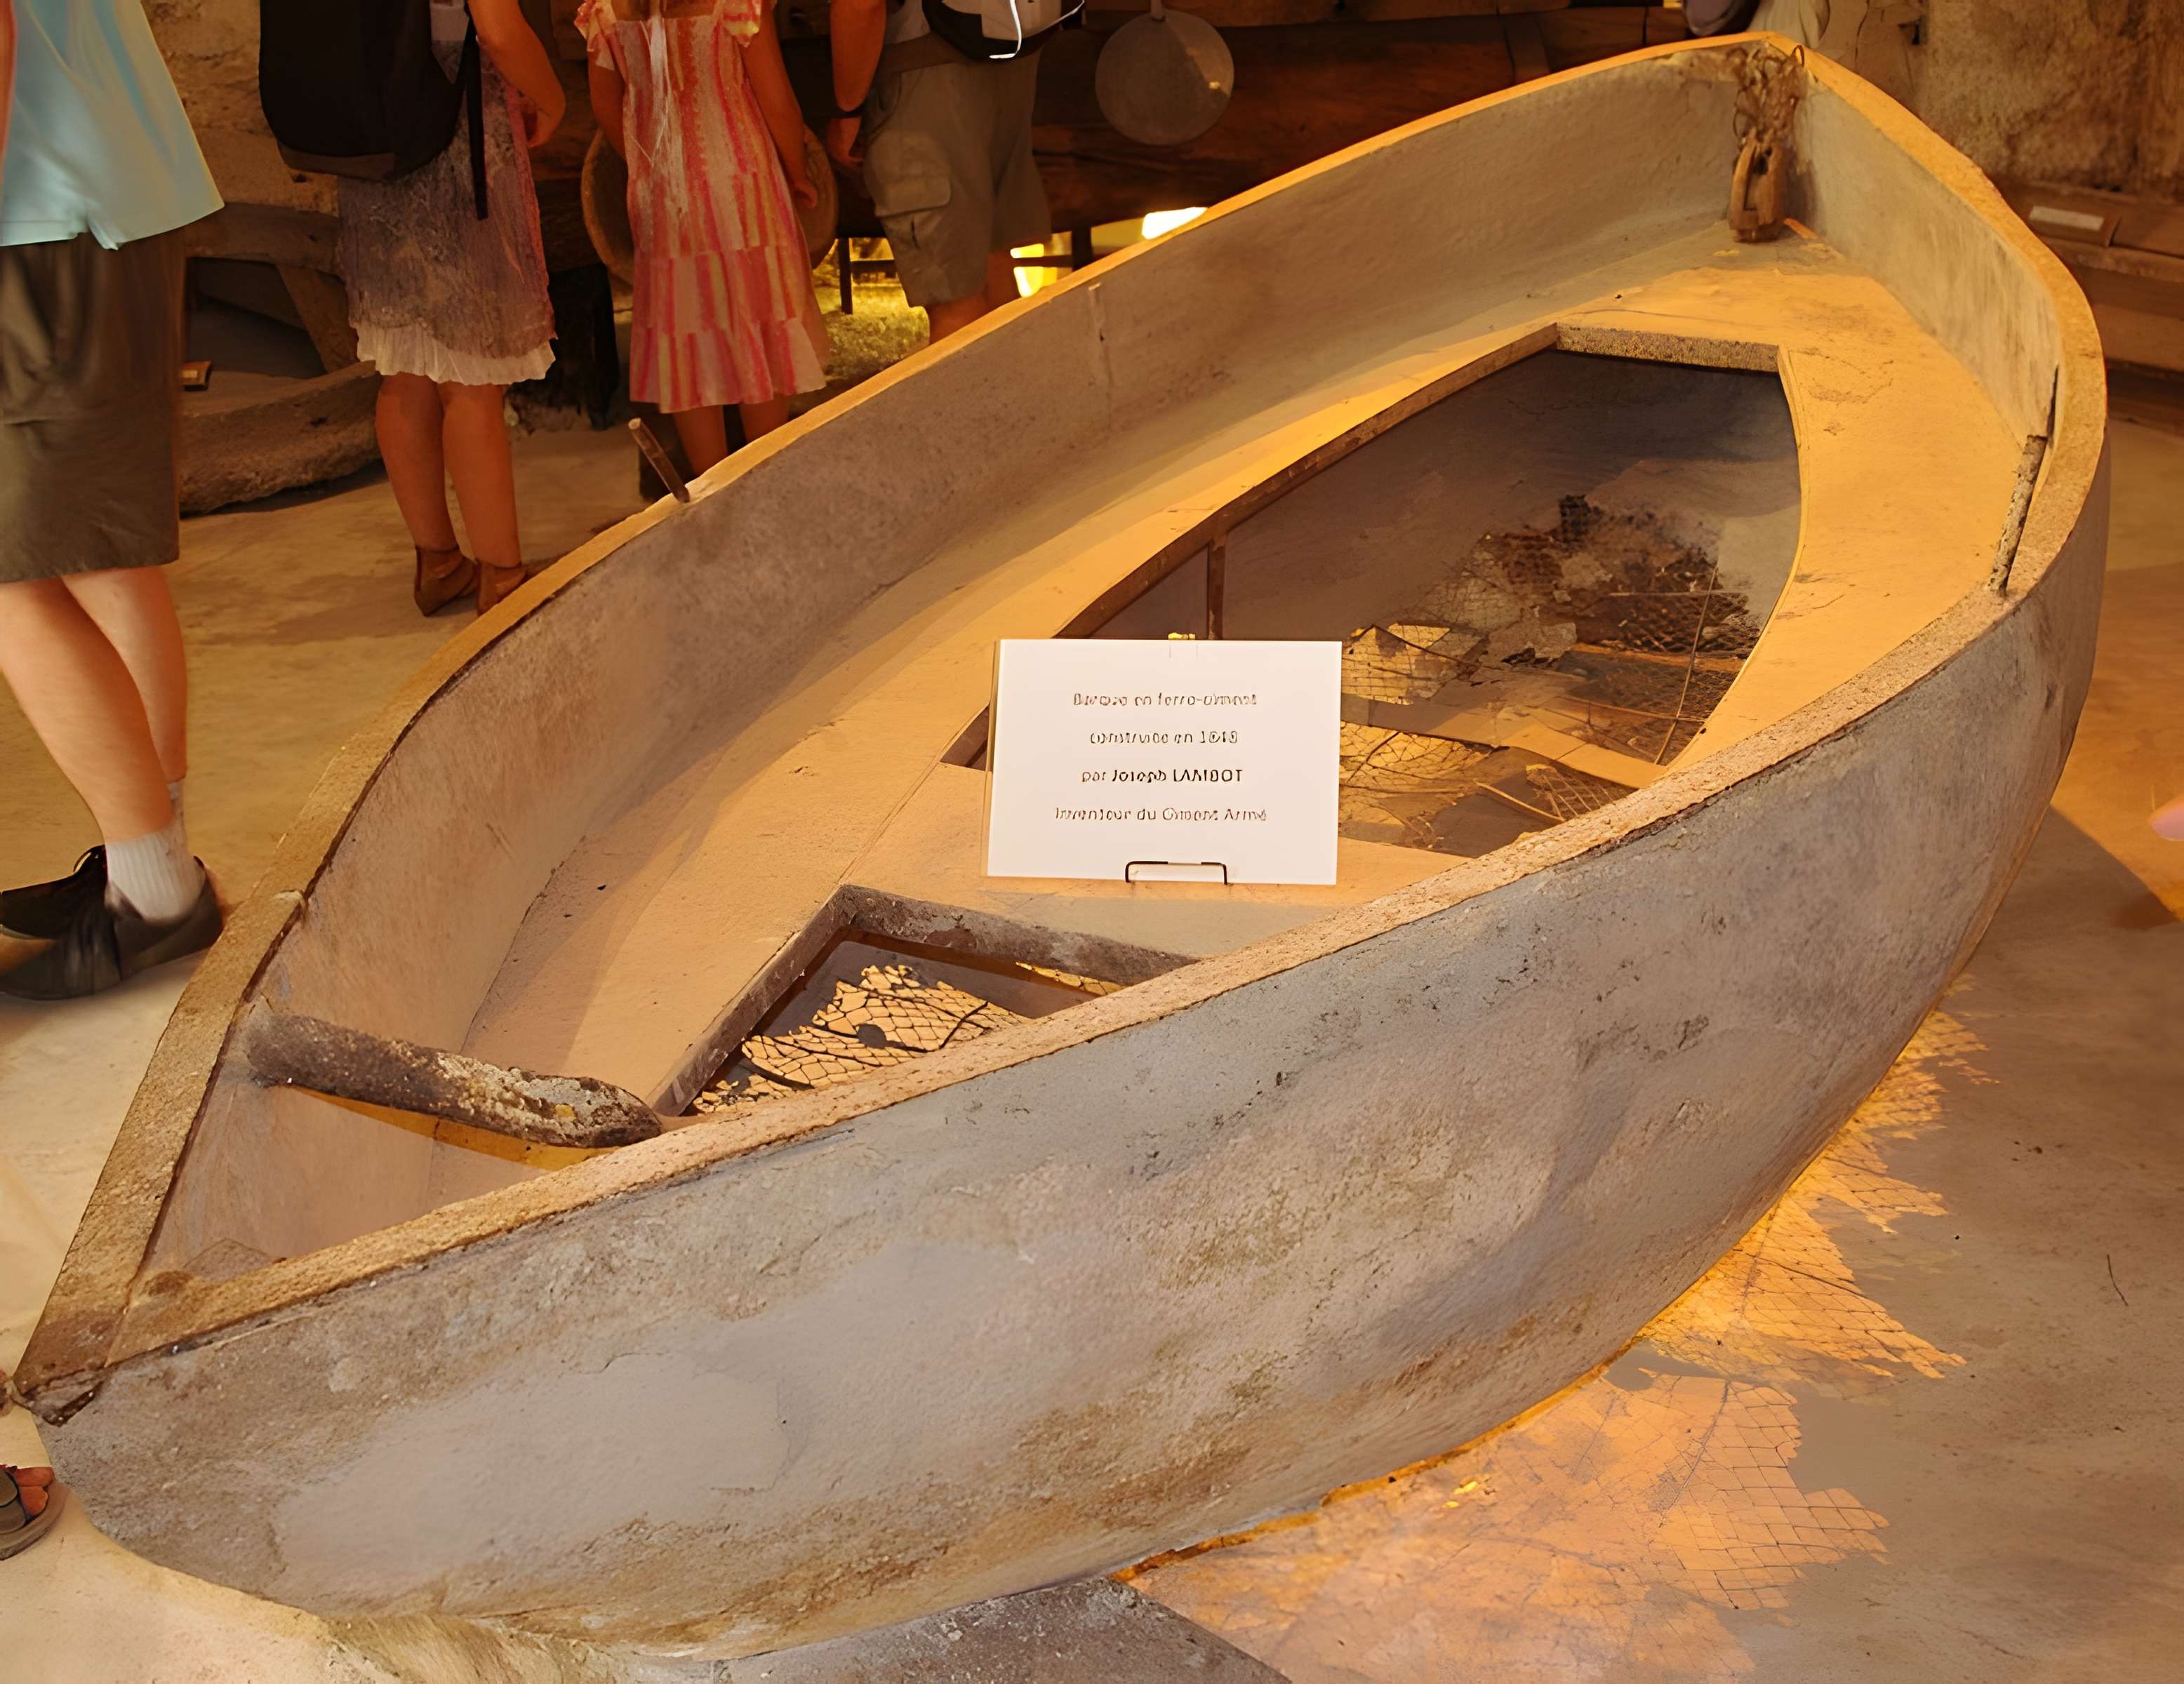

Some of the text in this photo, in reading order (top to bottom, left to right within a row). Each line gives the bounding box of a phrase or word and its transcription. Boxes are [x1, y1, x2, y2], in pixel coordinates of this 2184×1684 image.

[1134, 695, 1152, 707] en
[1173, 733, 1193, 744] en
[1081, 770, 1107, 783] par
[1136, 807, 1157, 820] du
